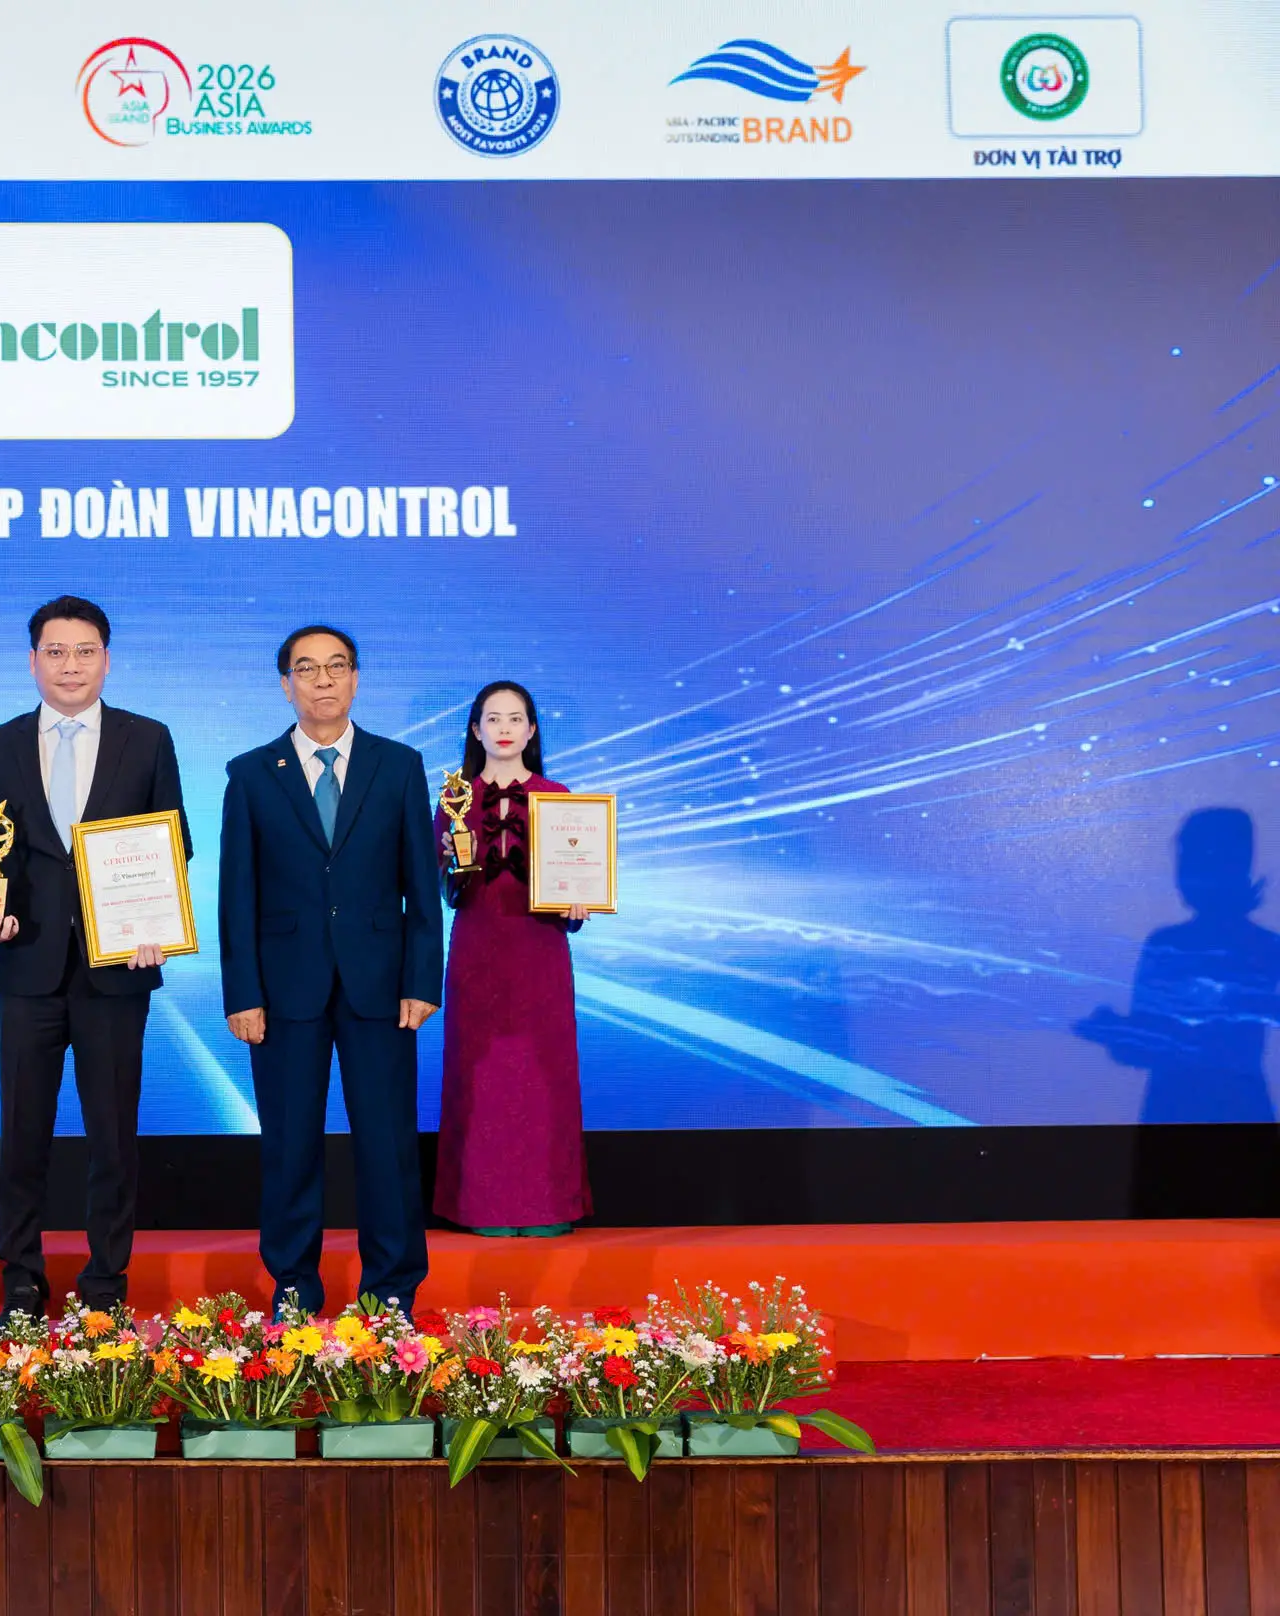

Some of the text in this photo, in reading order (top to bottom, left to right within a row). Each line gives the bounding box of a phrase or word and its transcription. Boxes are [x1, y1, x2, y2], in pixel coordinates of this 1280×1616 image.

[461, 45, 533, 69] BRAND
[197, 64, 276, 90] 2026
[194, 92, 265, 118] ASIA
[166, 118, 312, 135] BUSINESS AWARDS
[696, 116, 740, 127] PACIFIC
[743, 116, 853, 144] BRAND
[973, 145, 1123, 169] ĐƠN VỊ TÀI TRỢ
[101, 370, 260, 387] SINCE 1957
[39, 480, 170, 540] ĐOÀN
[185, 486, 517, 539] VINACONTROL
